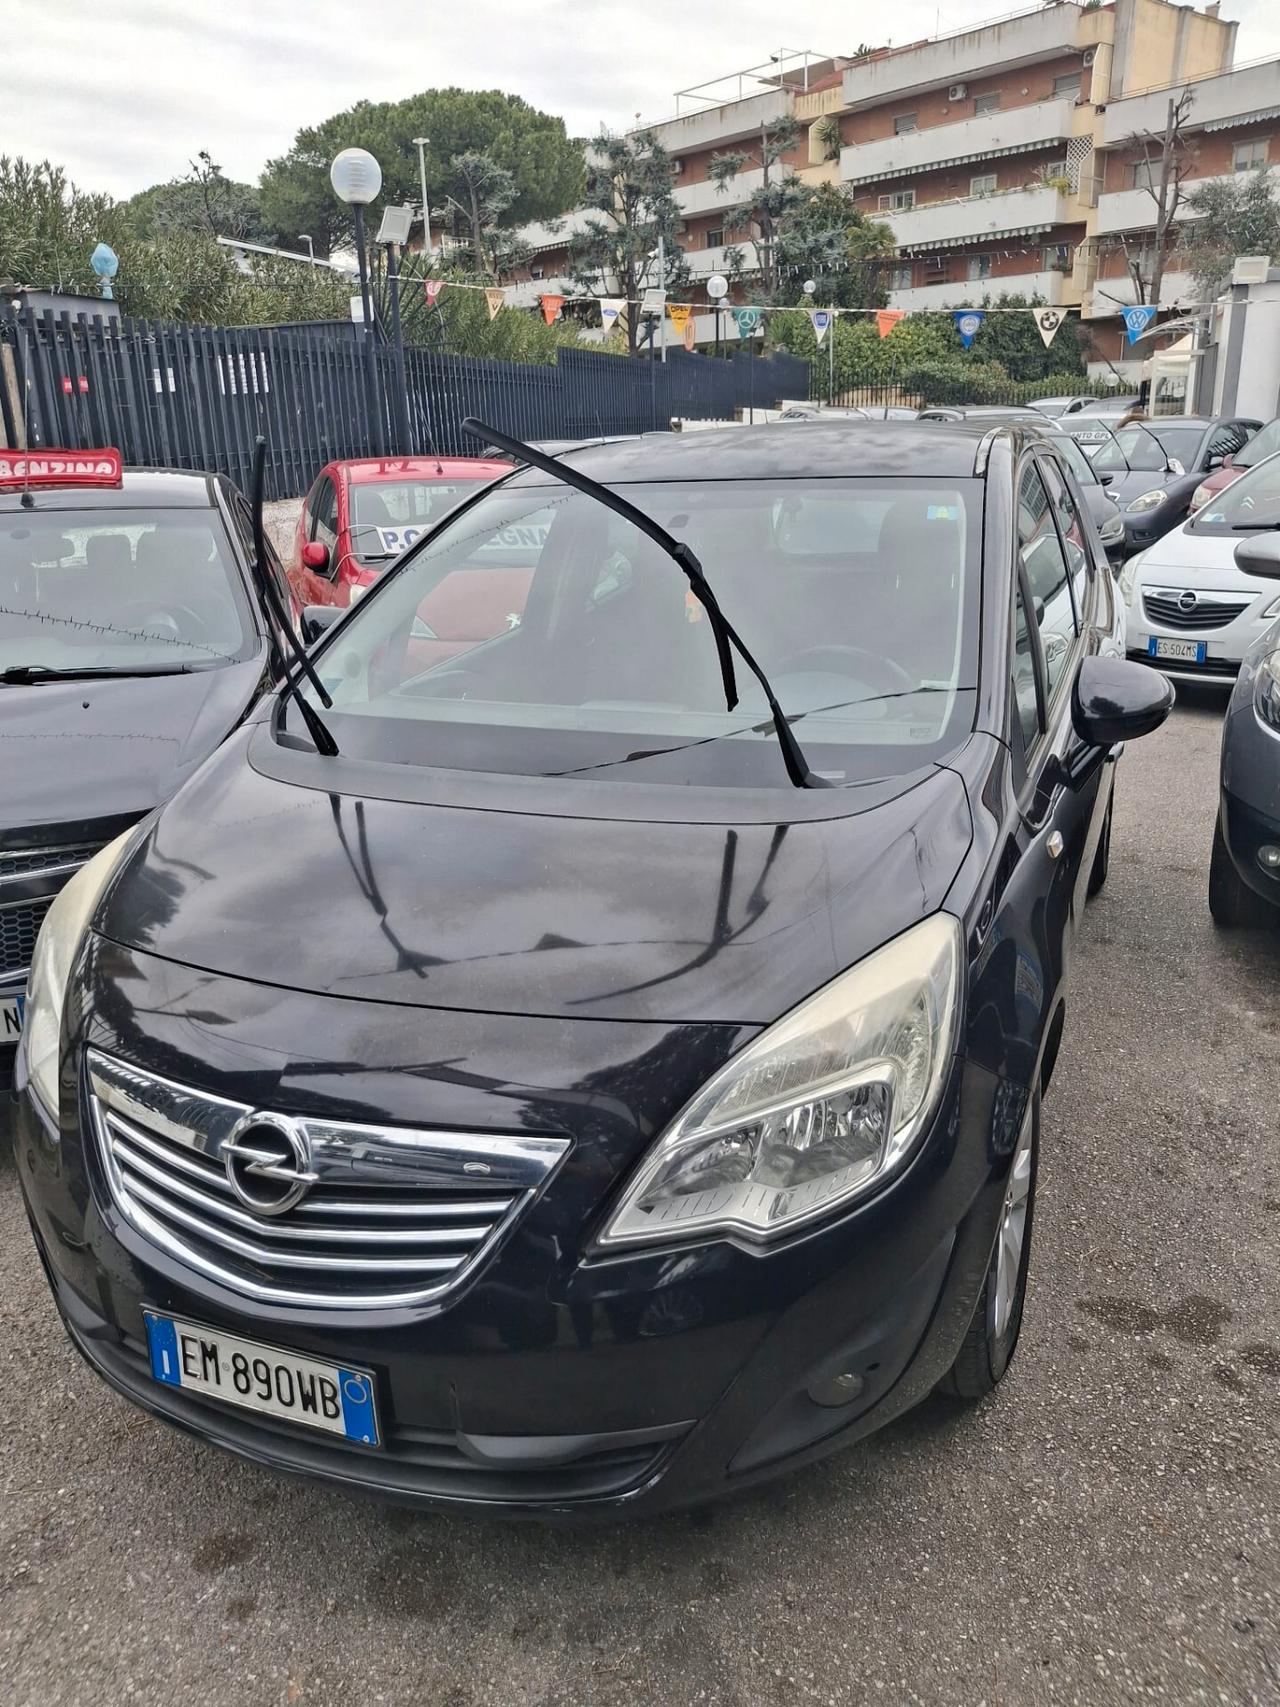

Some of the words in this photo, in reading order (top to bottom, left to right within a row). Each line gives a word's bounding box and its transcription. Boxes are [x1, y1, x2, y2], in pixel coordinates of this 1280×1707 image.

[670, 305, 690, 313] OPEL
[1094, 432, 1109, 440] GPL
[0, 460, 112, 477] BENZINA
[1157, 642, 1168, 654] ES
[1170, 643, 1197, 658] 504MS
[180, 1334, 222, 1386] EM
[231, 1352, 341, 1420] 890WB
